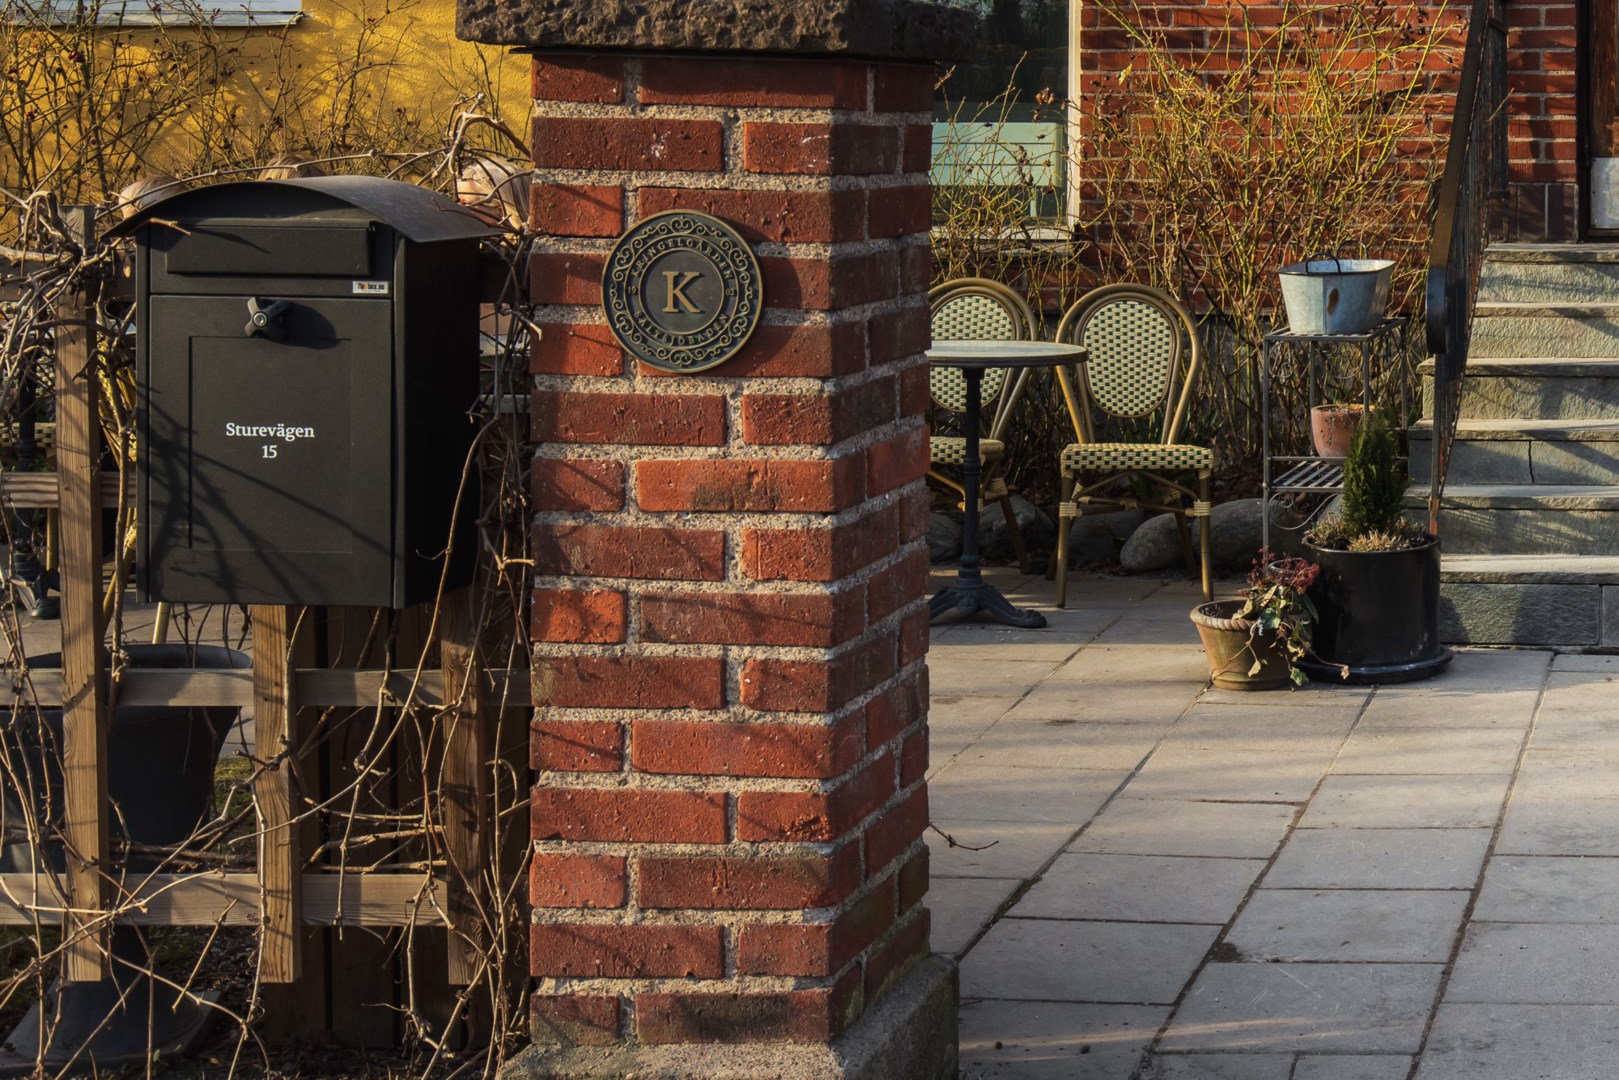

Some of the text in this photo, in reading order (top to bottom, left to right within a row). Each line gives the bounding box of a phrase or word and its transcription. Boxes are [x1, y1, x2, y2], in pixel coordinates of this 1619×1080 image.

[662, 270, 701, 313] K
[225, 422, 316, 442] Sturevägen
[261, 444, 278, 459] 15
